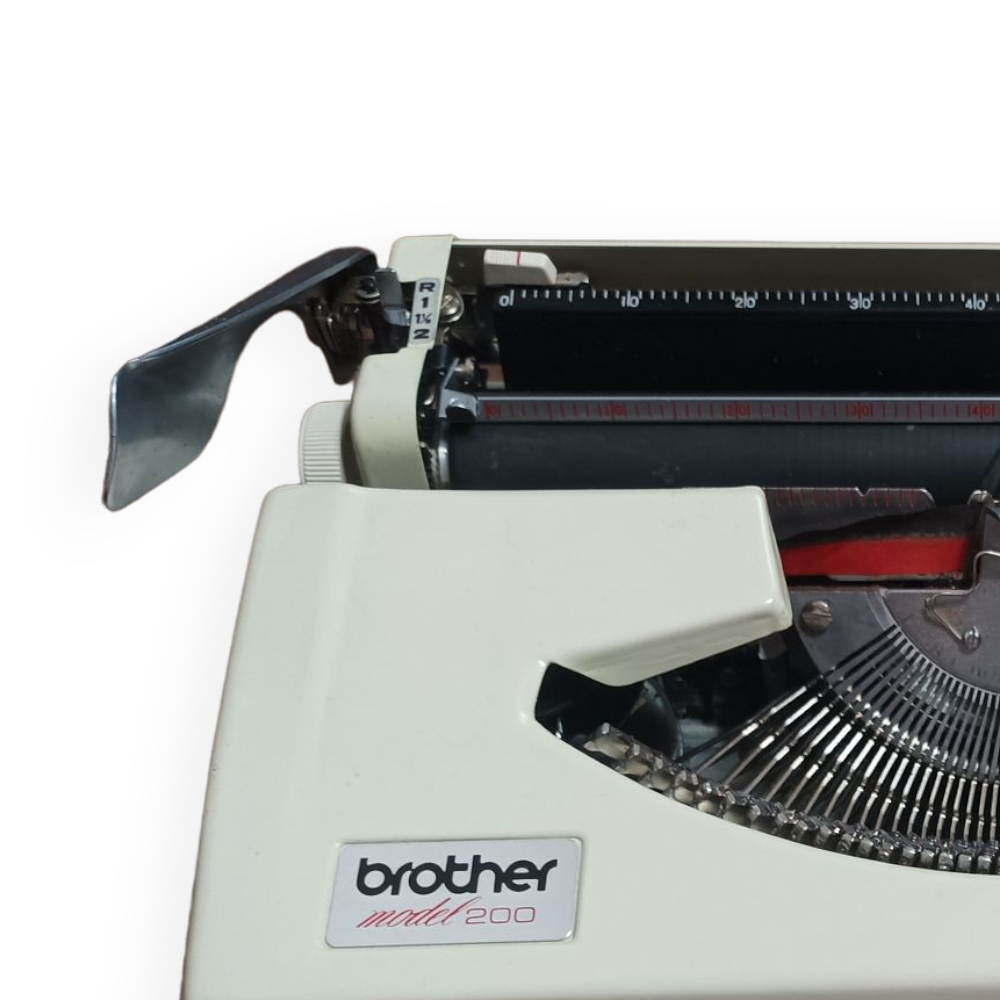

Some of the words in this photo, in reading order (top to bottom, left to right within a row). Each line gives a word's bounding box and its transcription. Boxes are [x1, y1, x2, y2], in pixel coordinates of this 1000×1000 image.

[420, 283, 435, 292] R
[422, 297, 429, 308] 1
[734, 298, 756, 308] 20
[850, 299, 871, 309] 30
[965, 299, 985, 310] 40
[414, 329, 430, 339] 2
[356, 855, 558, 896] brother
[356, 896, 481, 928] model
[465, 906, 536, 925] 200
